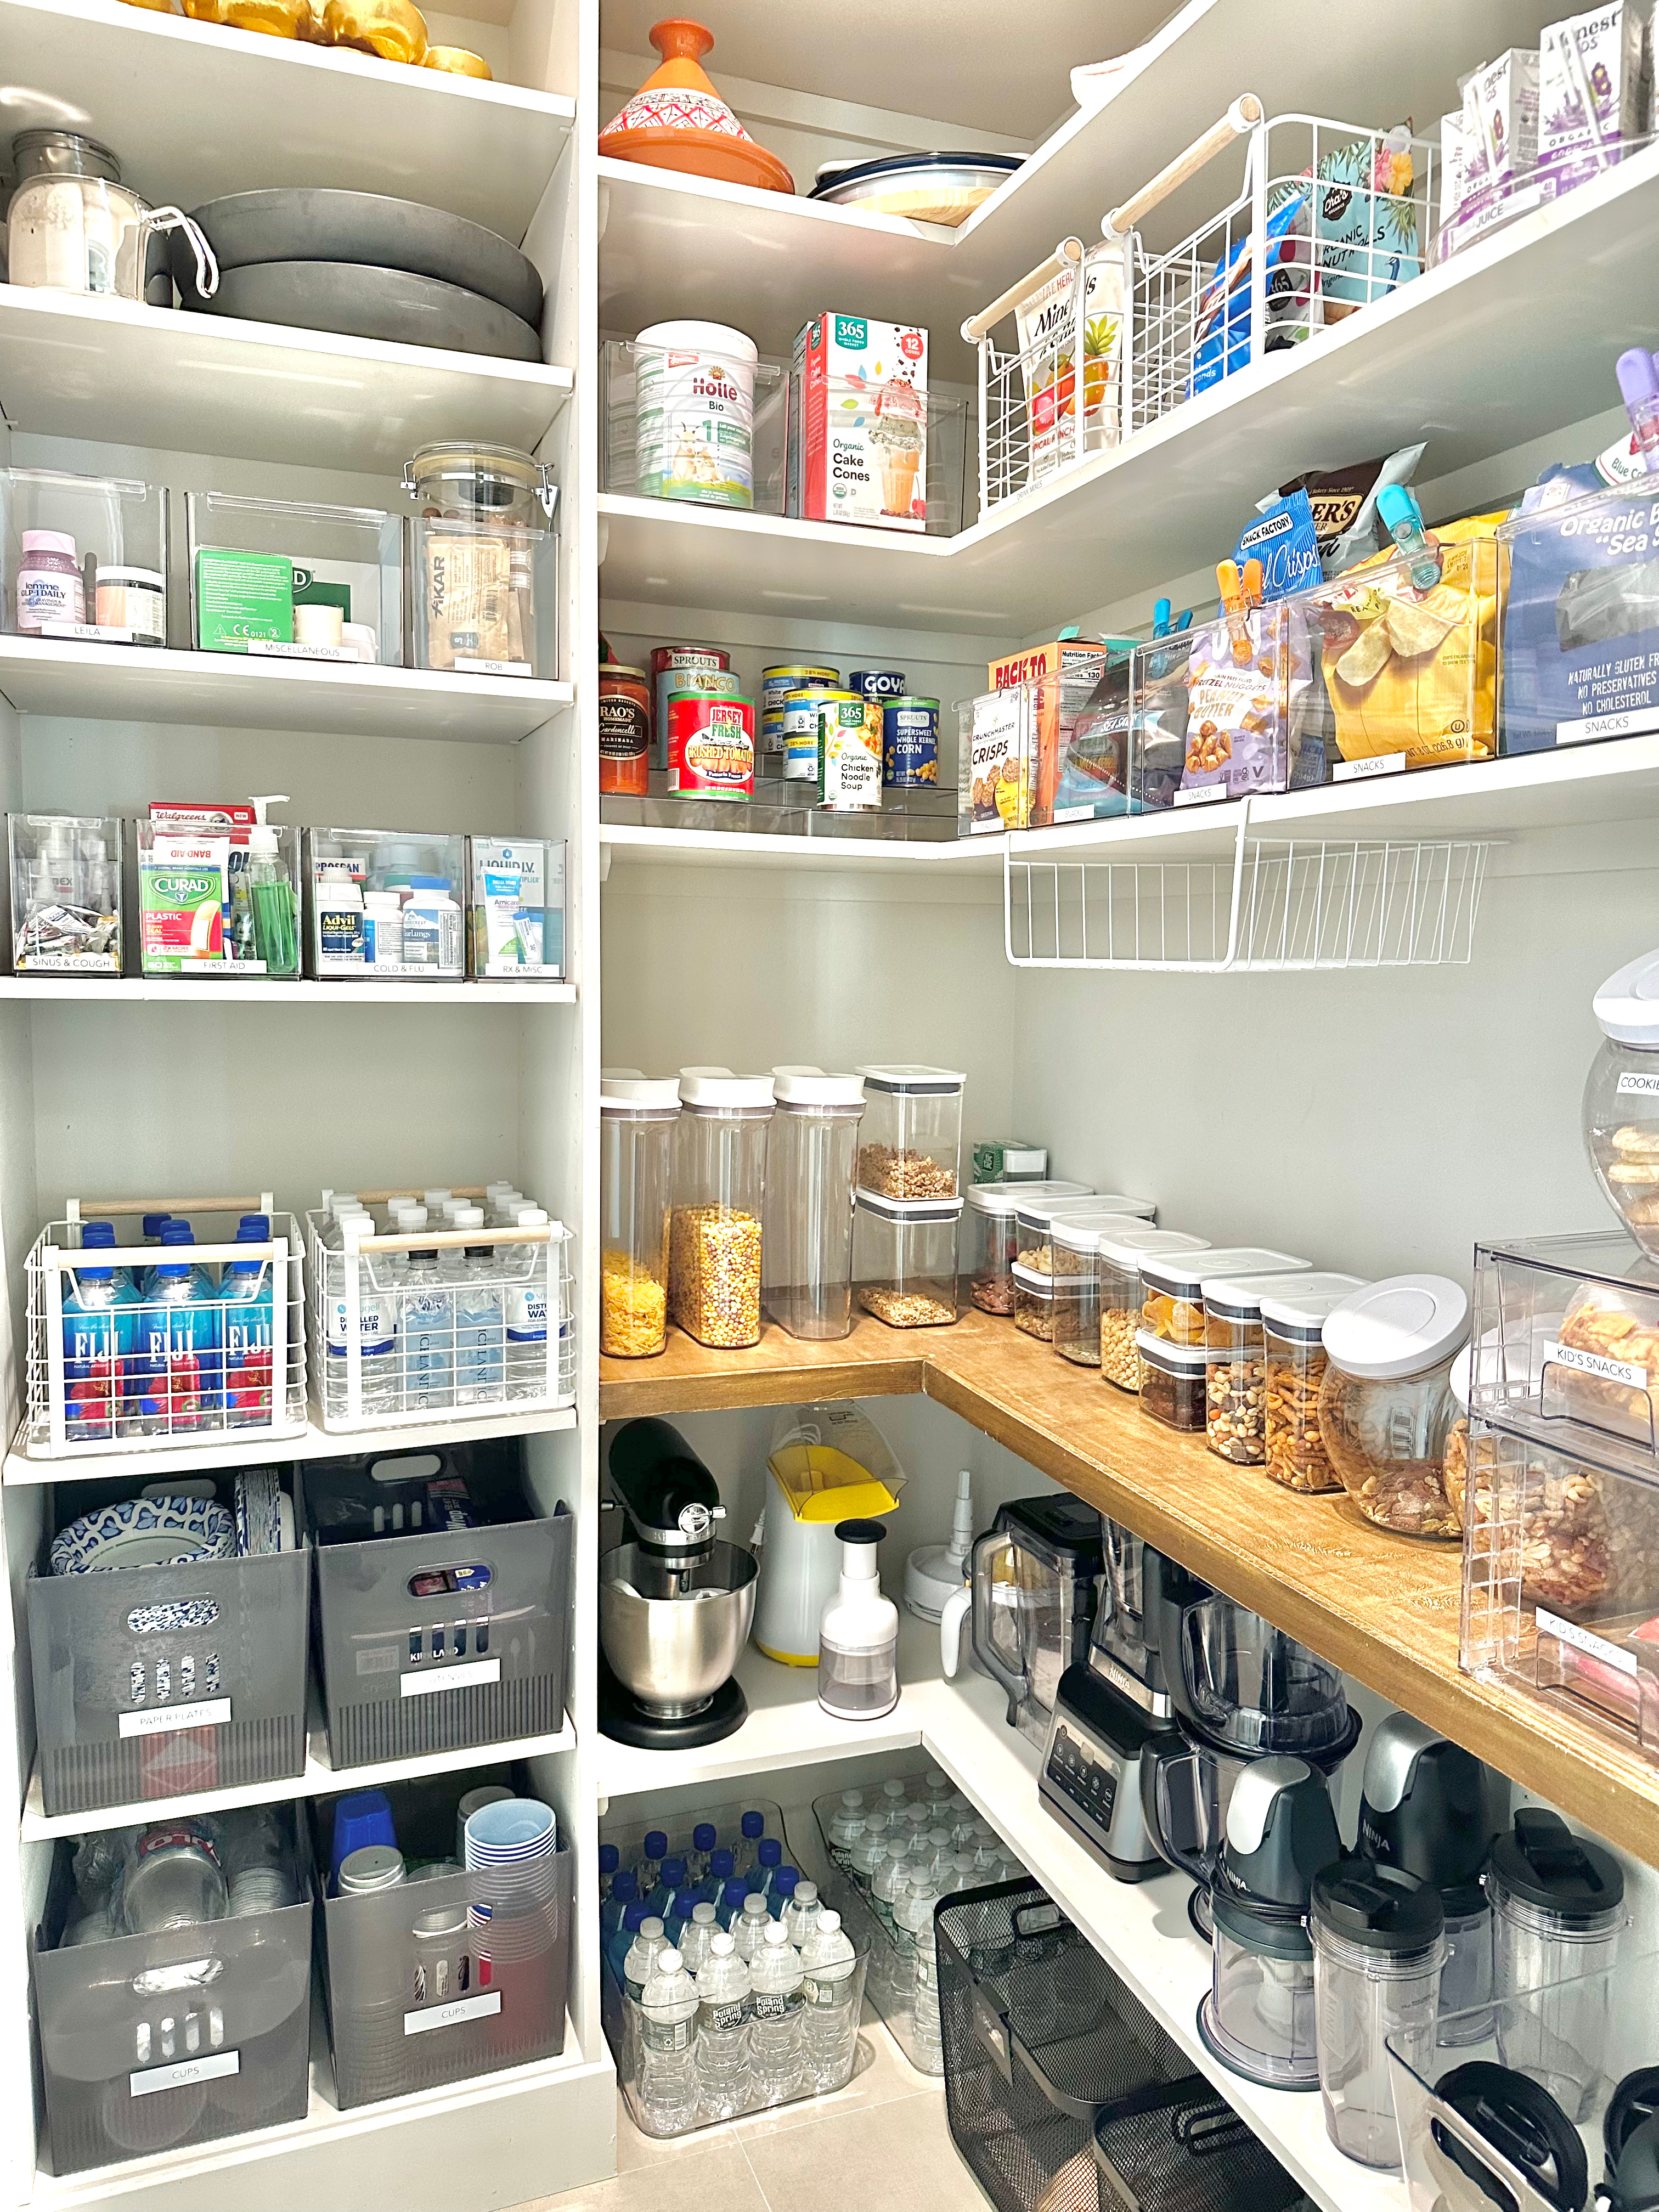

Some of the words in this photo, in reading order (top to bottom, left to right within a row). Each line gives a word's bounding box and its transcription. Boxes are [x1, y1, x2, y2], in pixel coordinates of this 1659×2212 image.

[1325, 189, 1348, 212] Cha's
[1476, 203, 1504, 228] JUICE
[1323, 225, 1363, 255] RGANIC
[811, 324, 821, 342] 365
[838, 321, 865, 339] 365
[906, 337, 919, 350] 12
[693, 377, 737, 401] Holle
[709, 400, 724, 411] Bio
[702, 420, 712, 441] 1
[833, 439, 864, 452] Organic
[833, 453, 864, 466] Cake
[833, 467, 870, 481] Cones
[1611, 458, 1628, 477] Blue
[1017, 488, 1029, 500] DRINK
[1030, 480, 1042, 493] MIXES
[1560, 509, 1645, 537] Organic
[1242, 531, 1261, 546] SNACK
[1261, 516, 1290, 537] FACTORY
[1273, 544, 1317, 588] Crisps
[26, 582, 60, 591] lemme
[41, 590, 66, 599] DAILY
[75, 626, 101, 636] LEILA
[265, 644, 340, 657] MISCELLANEOUS
[674, 656, 718, 667] SPROUTS
[1568, 663, 1612, 685] NATURALLY
[1615, 655, 1645, 674] GLUTEN
[1649, 652, 1659, 668] FR
[996, 657, 1029, 689] BACK
[1030, 653, 1046, 679] TO
[675, 673, 735, 692] BIANCO
[865, 675, 905, 693] GOYA
[1224, 681, 1266, 691] NUGGETS
[1577, 685, 1588, 699] NO
[1592, 671, 1657, 697] PRESERVATIVES
[1200, 689, 1246, 706] PEANUT
[1582, 702, 1593, 715] NO
[1596, 691, 1651, 713] CHOLESTEROL
[599, 706, 635, 719] RAO'S
[712, 709, 742, 724] JERSEY
[840, 706, 862, 719] 365
[1194, 703, 1234, 719] BUTTER
[599, 723, 636, 735] Cardoncelli
[712, 724, 741, 739] FRESH
[973, 722, 1015, 741] CRUNCHMASTER
[1100, 719, 1116, 732] SEA
[1585, 715, 1629, 734] SNACKS
[687, 745, 724, 759] CRUSHED
[896, 744, 922, 754] CORN
[972, 740, 1009, 765] CRISPS
[1407, 748, 1418, 758] WT
[1418, 747, 1424, 755] 8
[1424, 746, 1432, 755] OZ
[841, 752, 867, 762] Organic
[841, 763, 874, 772] Chicken
[1353, 759, 1385, 773] SNACKS
[841, 772, 870, 781] Noodle
[841, 782, 862, 791] Soup
[1188, 788, 1211, 800] SNACKS
[155, 811, 207, 821] Walgreens
[522, 862, 534, 873] I.V.
[155, 878, 209, 893] CURAD
[145, 912, 182, 921] PLASTIC
[323, 915, 356, 925] Advil
[33, 958, 61, 966] SINUS
[75, 1331, 120, 1363] FIJI
[149, 1329, 194, 1363] FIJI
[228, 1323, 272, 1356] FIJI
[1558, 1348, 1583, 1365] KID'S
[1587, 1357, 1632, 1380] SNACKS
[429, 1671, 473, 1684] UTENSILS
[1109, 1663, 1130, 1689] NINJA
[140, 1714, 172, 1725] PAPER
[175, 1708, 211, 1720] PLATES
[1363, 1818, 1390, 1852] NINJA
[1227, 1866, 1247, 1891] NINJA
[756, 1994, 784, 2006] Poland
[442, 2006, 466, 2018] CUPS
[713, 2002, 741, 2020] Poland
[757, 2004, 785, 2016] Spring
[715, 2010, 742, 2028] Spring
[172, 2067, 199, 2079] CUPS
